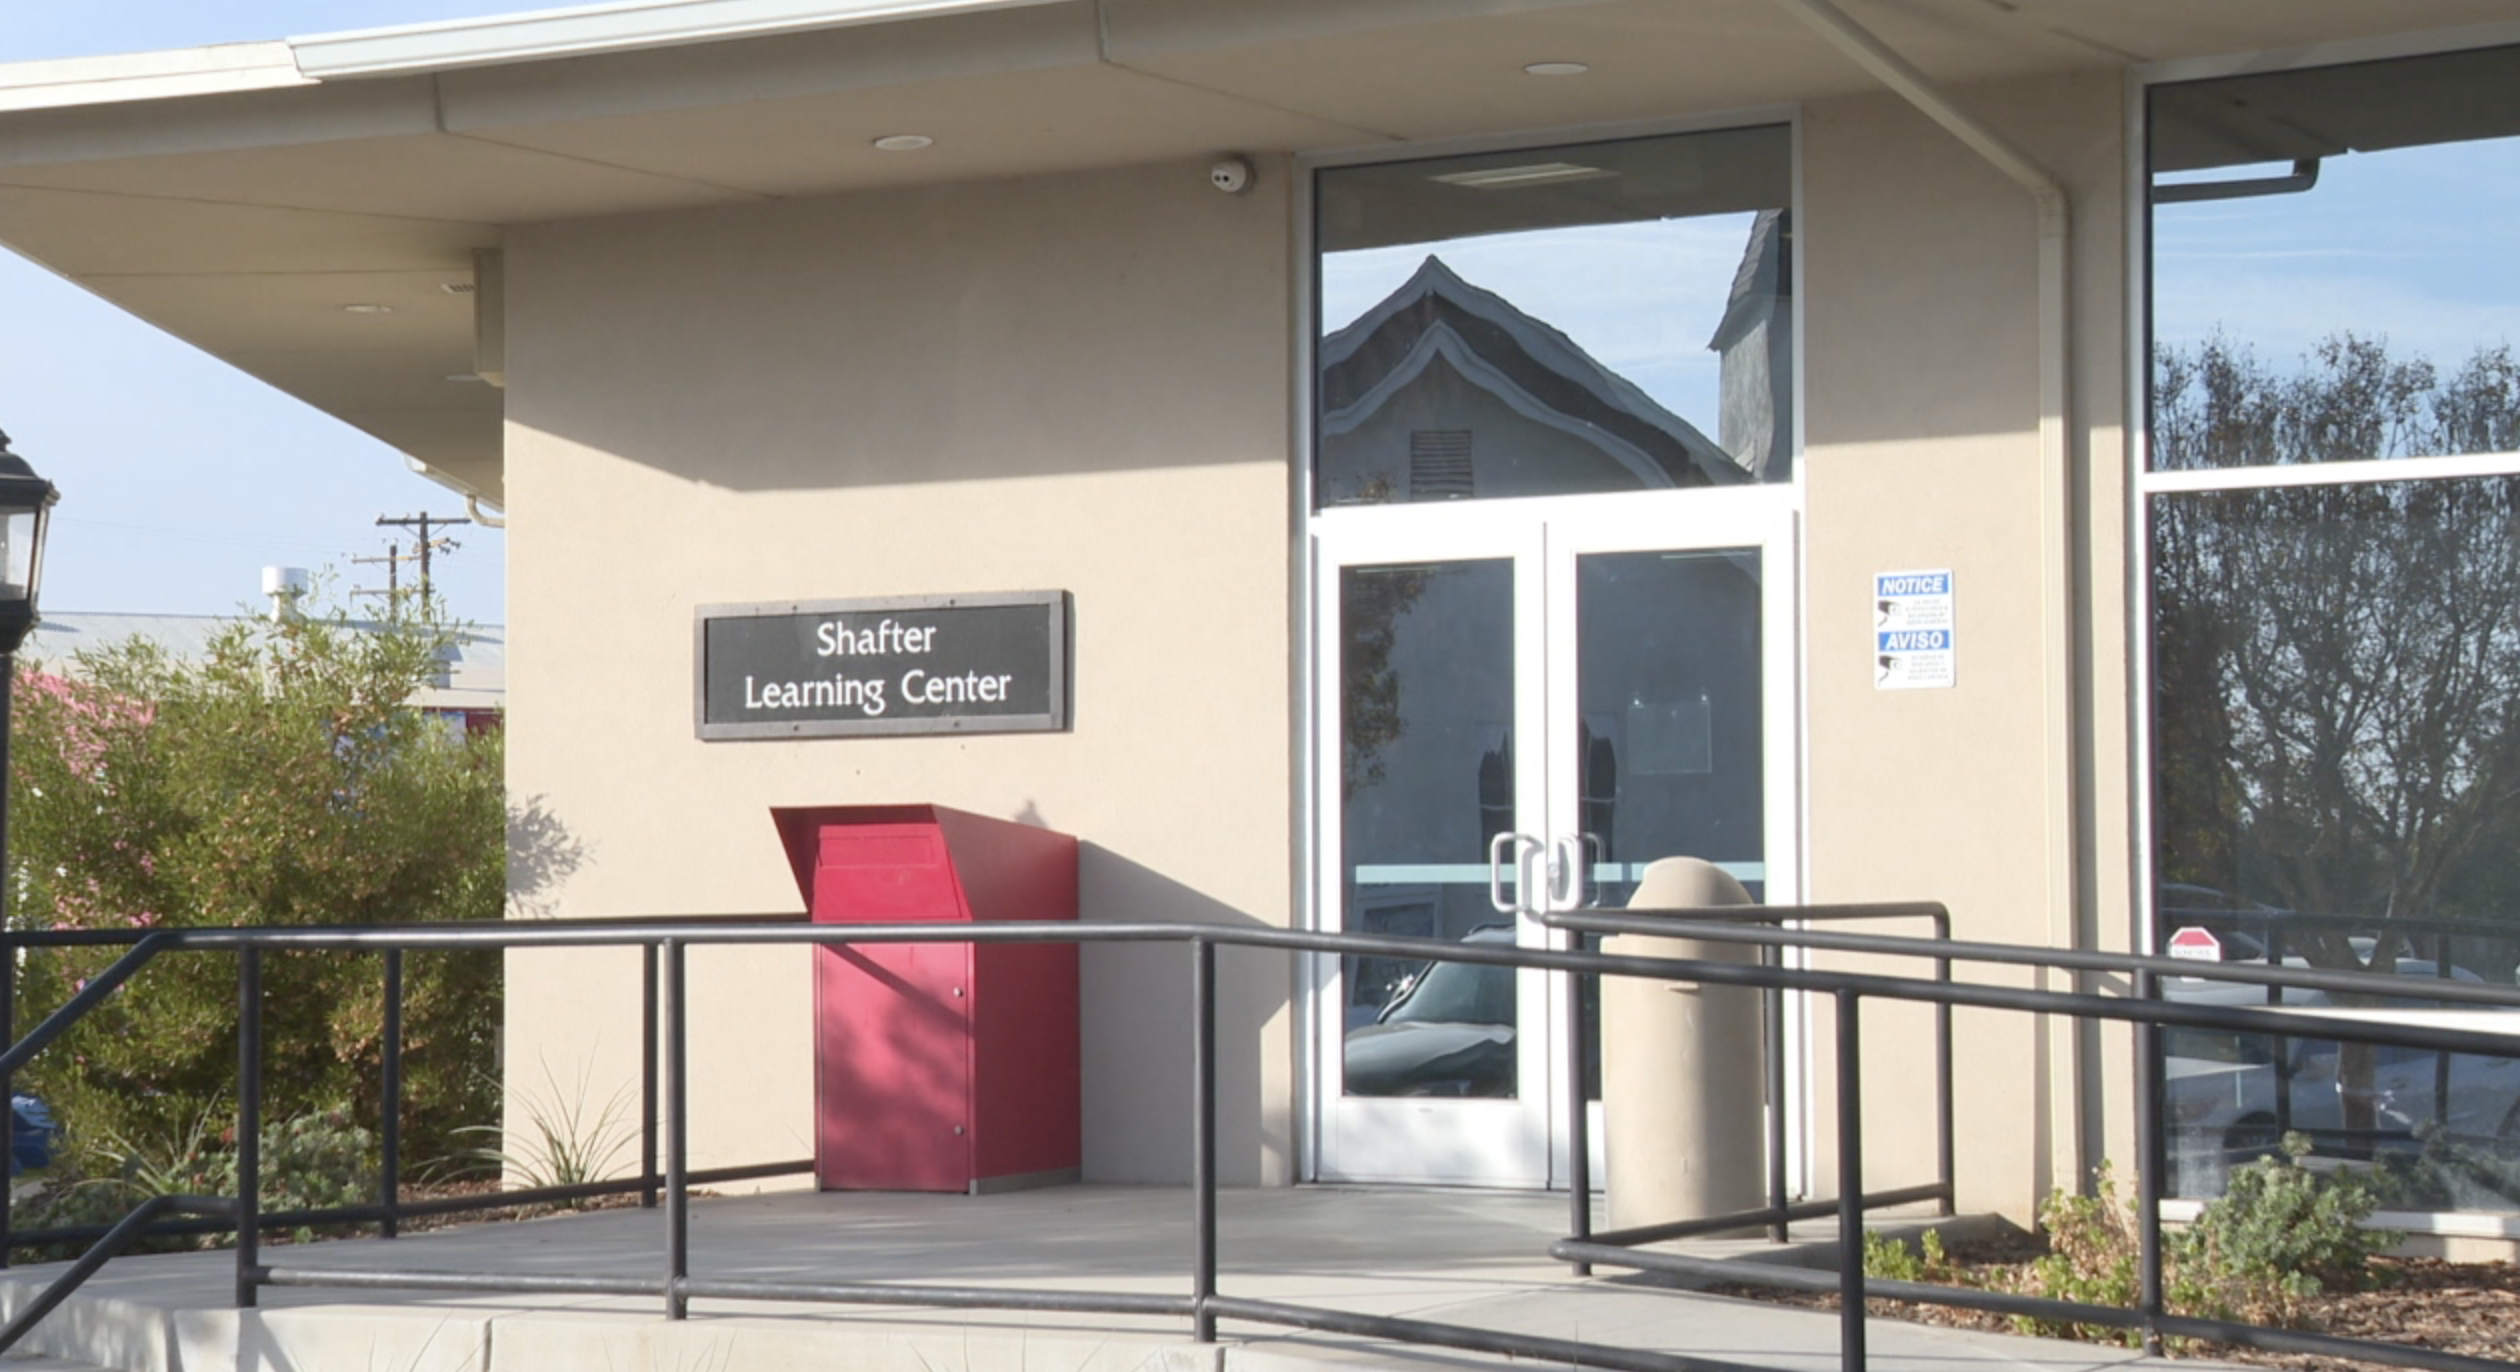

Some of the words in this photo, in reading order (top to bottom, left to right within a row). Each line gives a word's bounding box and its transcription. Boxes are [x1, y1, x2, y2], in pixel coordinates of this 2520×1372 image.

[1882, 577, 1944, 595] NOTICE
[817, 619, 937, 656] Shafter
[1885, 631, 1943, 650] AVISO
[745, 673, 886, 716] Learning
[901, 669, 1012, 704] Center
